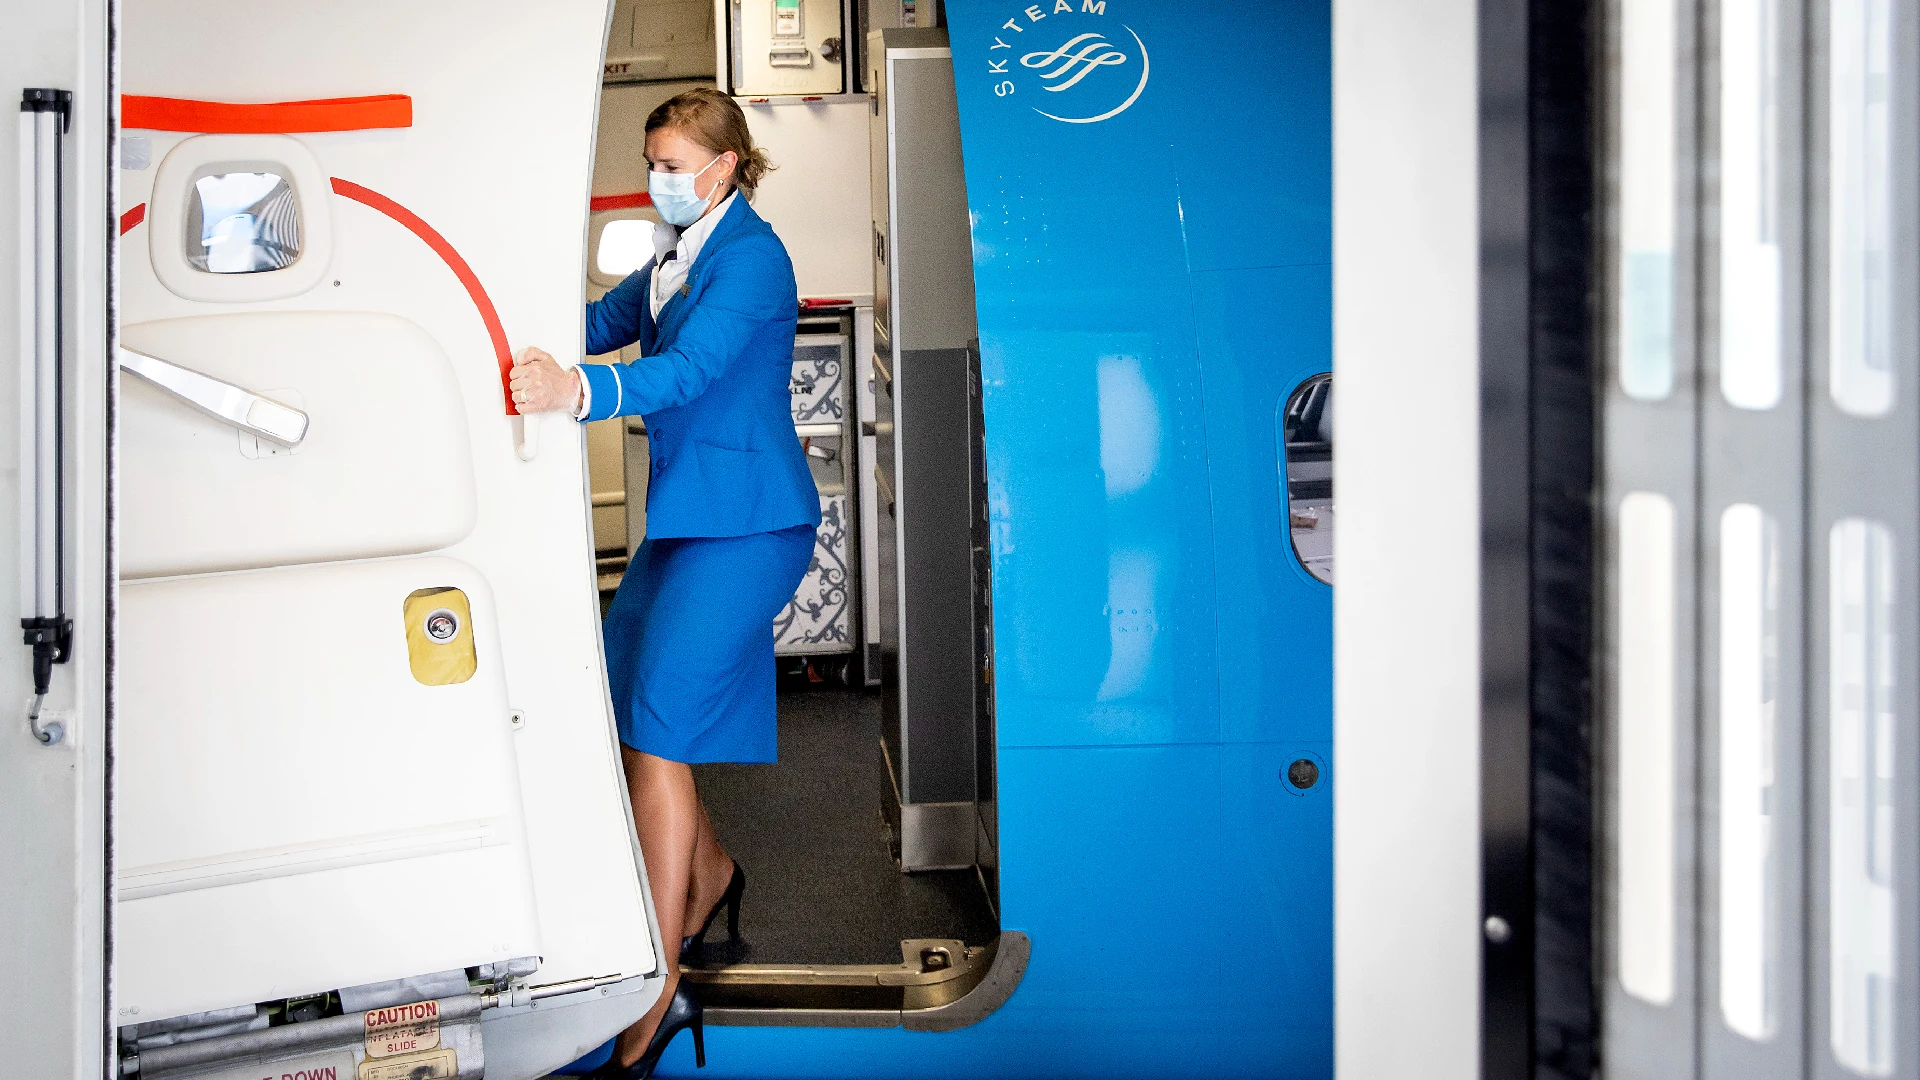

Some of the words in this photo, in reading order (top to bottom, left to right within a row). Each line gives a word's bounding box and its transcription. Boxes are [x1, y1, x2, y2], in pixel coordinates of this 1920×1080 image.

[988, 0, 1107, 97] SKYTEAM
[604, 63, 631, 74] XIT
[366, 1002, 437, 1027] CAUTION
[387, 1040, 417, 1053] SLIDE
